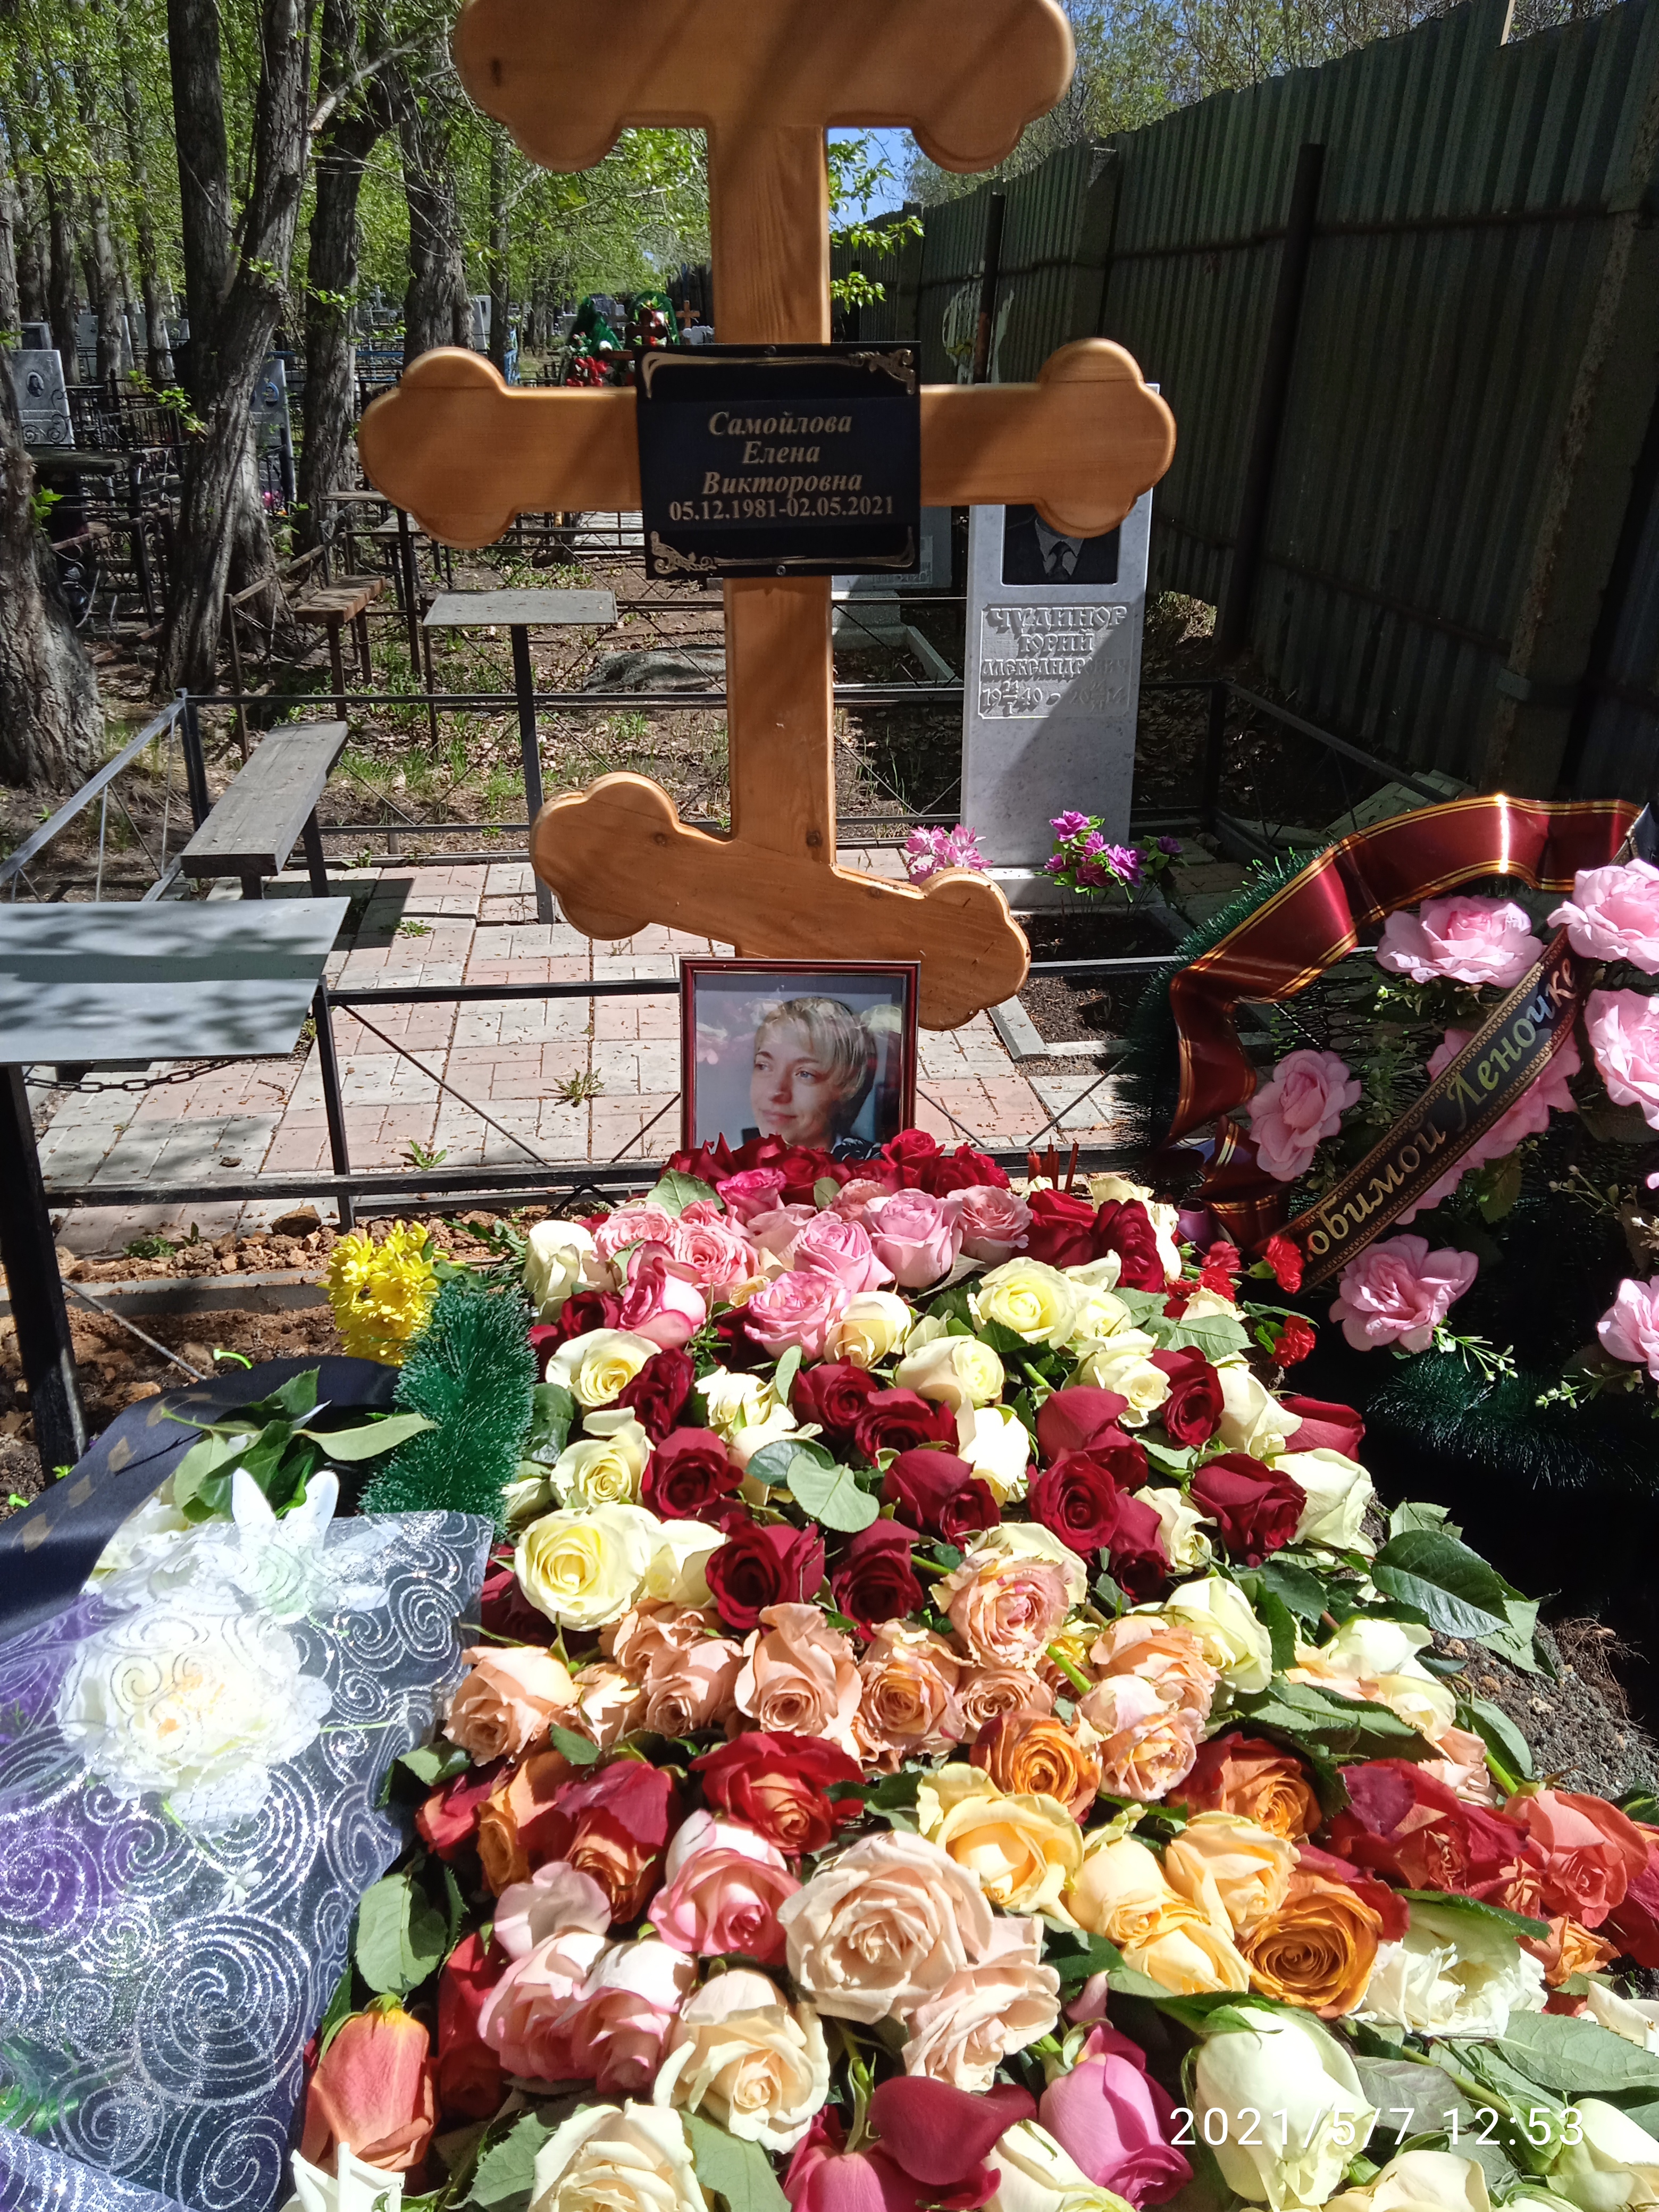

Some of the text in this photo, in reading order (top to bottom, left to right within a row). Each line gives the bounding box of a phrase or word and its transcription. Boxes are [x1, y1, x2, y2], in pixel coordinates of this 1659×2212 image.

[708, 410, 853, 436] Самойлова
[742, 440, 822, 465] Елена
[701, 471, 862, 498] Викторовна
[668, 496, 894, 521] 05.12.1981-02.05.2021
[1019, 629, 1094, 652] ЮРИЙ
[1306, 958, 1577, 1262] юбимой Леночке
